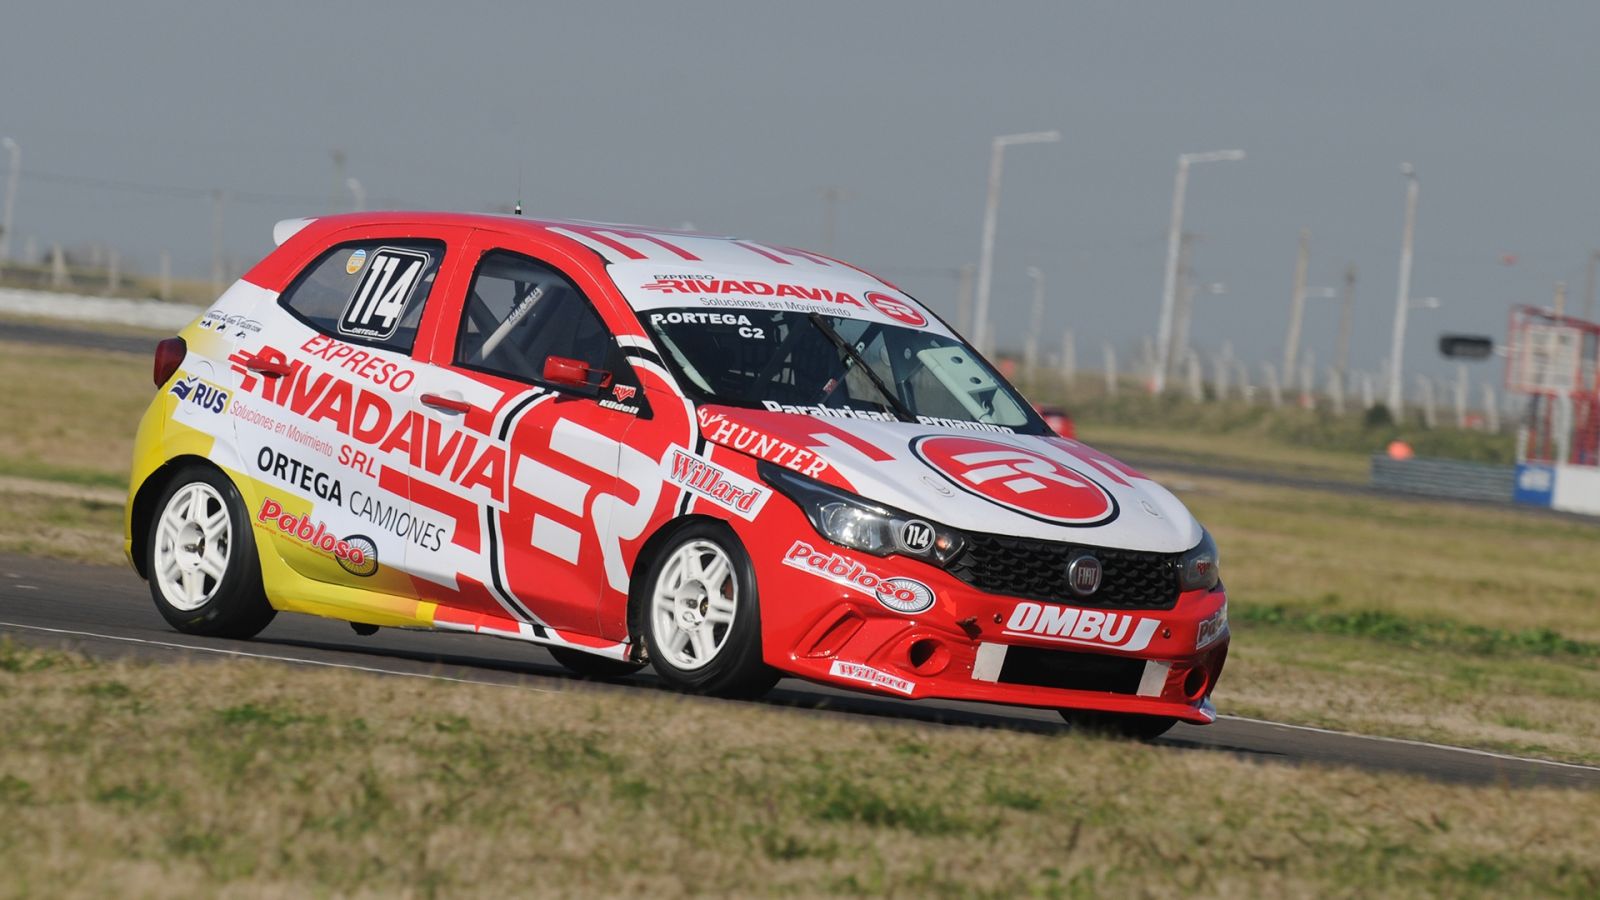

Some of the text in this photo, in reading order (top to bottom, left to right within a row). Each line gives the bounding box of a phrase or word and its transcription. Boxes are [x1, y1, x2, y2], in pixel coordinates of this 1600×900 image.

[348, 255, 422, 328] 114
[641, 279, 865, 308] RIVADAVIA
[699, 297, 852, 317] Soluciones en Movimiento
[352, 327, 379, 336] ORTEGA
[650, 312, 752, 326] P.ORTEGA
[738, 326, 765, 339] C2
[300, 334, 415, 392] EXPRESO
[192, 382, 228, 414] RUS
[229, 344, 505, 503] RIVADAVIA
[230, 400, 378, 479] Soluciones en Movimiento SRL
[915, 415, 1015, 434] ergamino
[711, 419, 829, 479] HUNTER
[257, 446, 342, 507] ORTEGA
[349, 490, 447, 553] CAMIONES
[670, 449, 759, 513] Willard
[258, 497, 366, 566] Pabloso
[906, 525, 929, 548] 114
[788, 542, 917, 603] Pabloso
[1077, 568, 1098, 587] FIAT
[1006, 602, 1133, 644] OMBU
[838, 663, 909, 691] Willard
